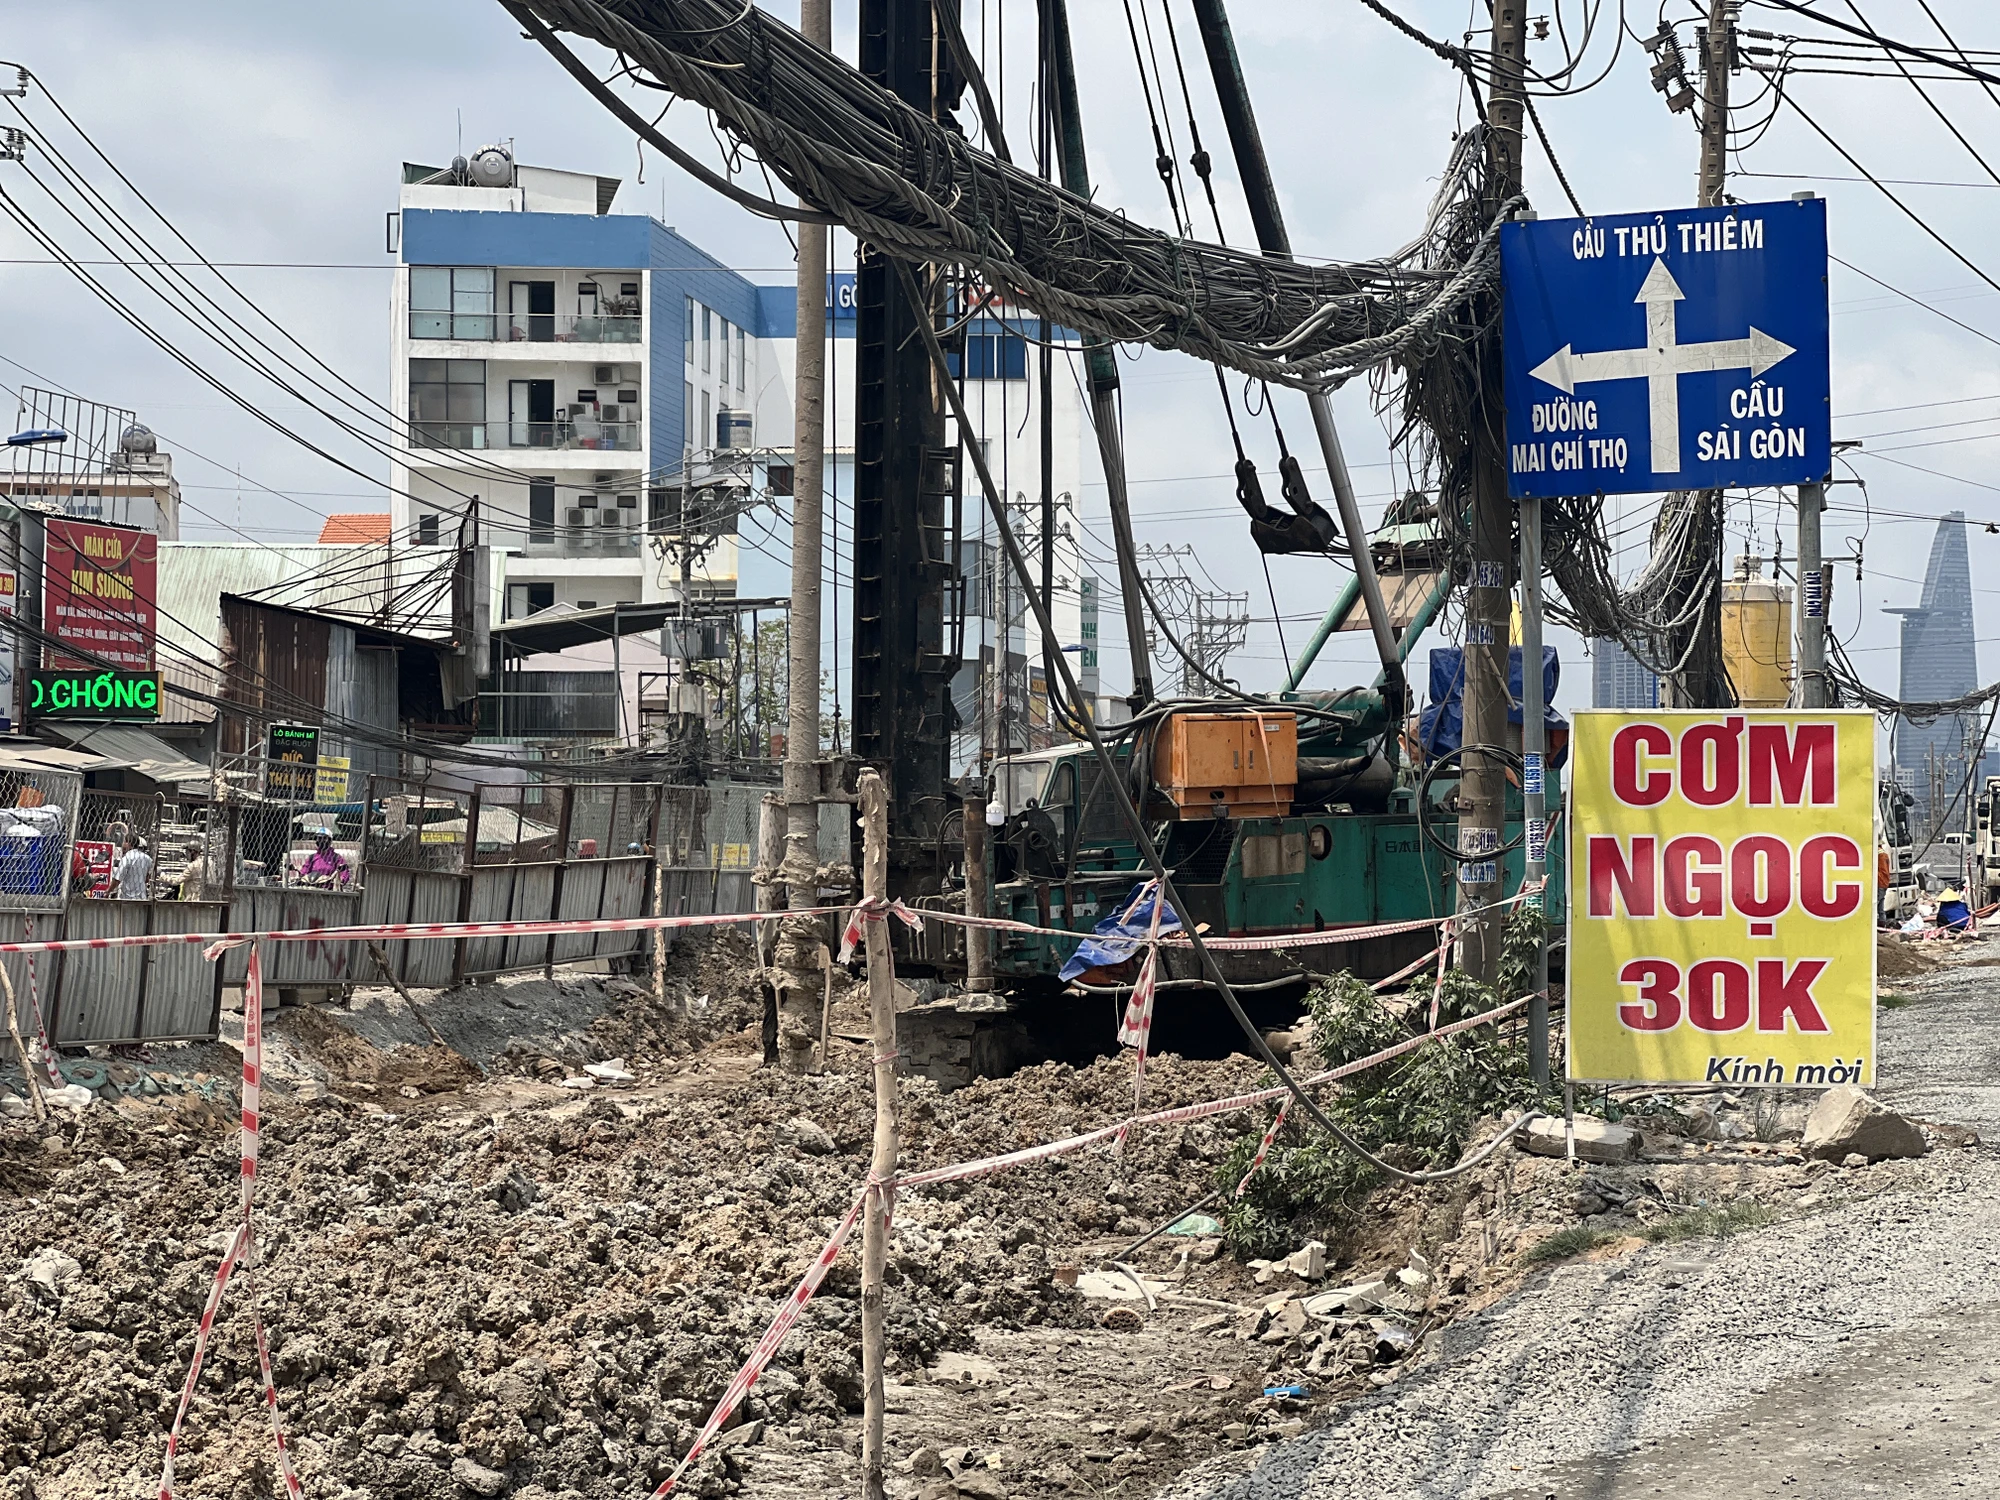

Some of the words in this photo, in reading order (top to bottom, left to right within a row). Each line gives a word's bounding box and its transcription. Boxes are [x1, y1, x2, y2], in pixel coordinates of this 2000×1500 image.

[1572, 217, 1605, 260] CẦU
[1614, 215, 1667, 257] THỦ
[1677, 215, 1764, 253] THIÊM
[1532, 395, 1598, 433] ĐƯỜNG
[1730, 379, 1784, 419] CẦU
[1512, 443, 1545, 474] MAI
[1551, 434, 1583, 471] CHÍ
[1592, 437, 1628, 474] THỌ
[1697, 423, 1740, 462] SÀI
[1750, 421, 1806, 459] GÒN
[84, 533, 104, 557] MÀN
[105, 533, 122, 559] CỬA
[71, 570, 94, 595] KIM
[51, 672, 157, 708] CHỐNG
[1612, 715, 1836, 807] CƠM
[1588, 835, 1862, 937] NGỌC
[1617, 958, 1830, 1033] 30K
[1705, 1057, 1784, 1083] Kính
[1797, 1057, 1863, 1084] mời
